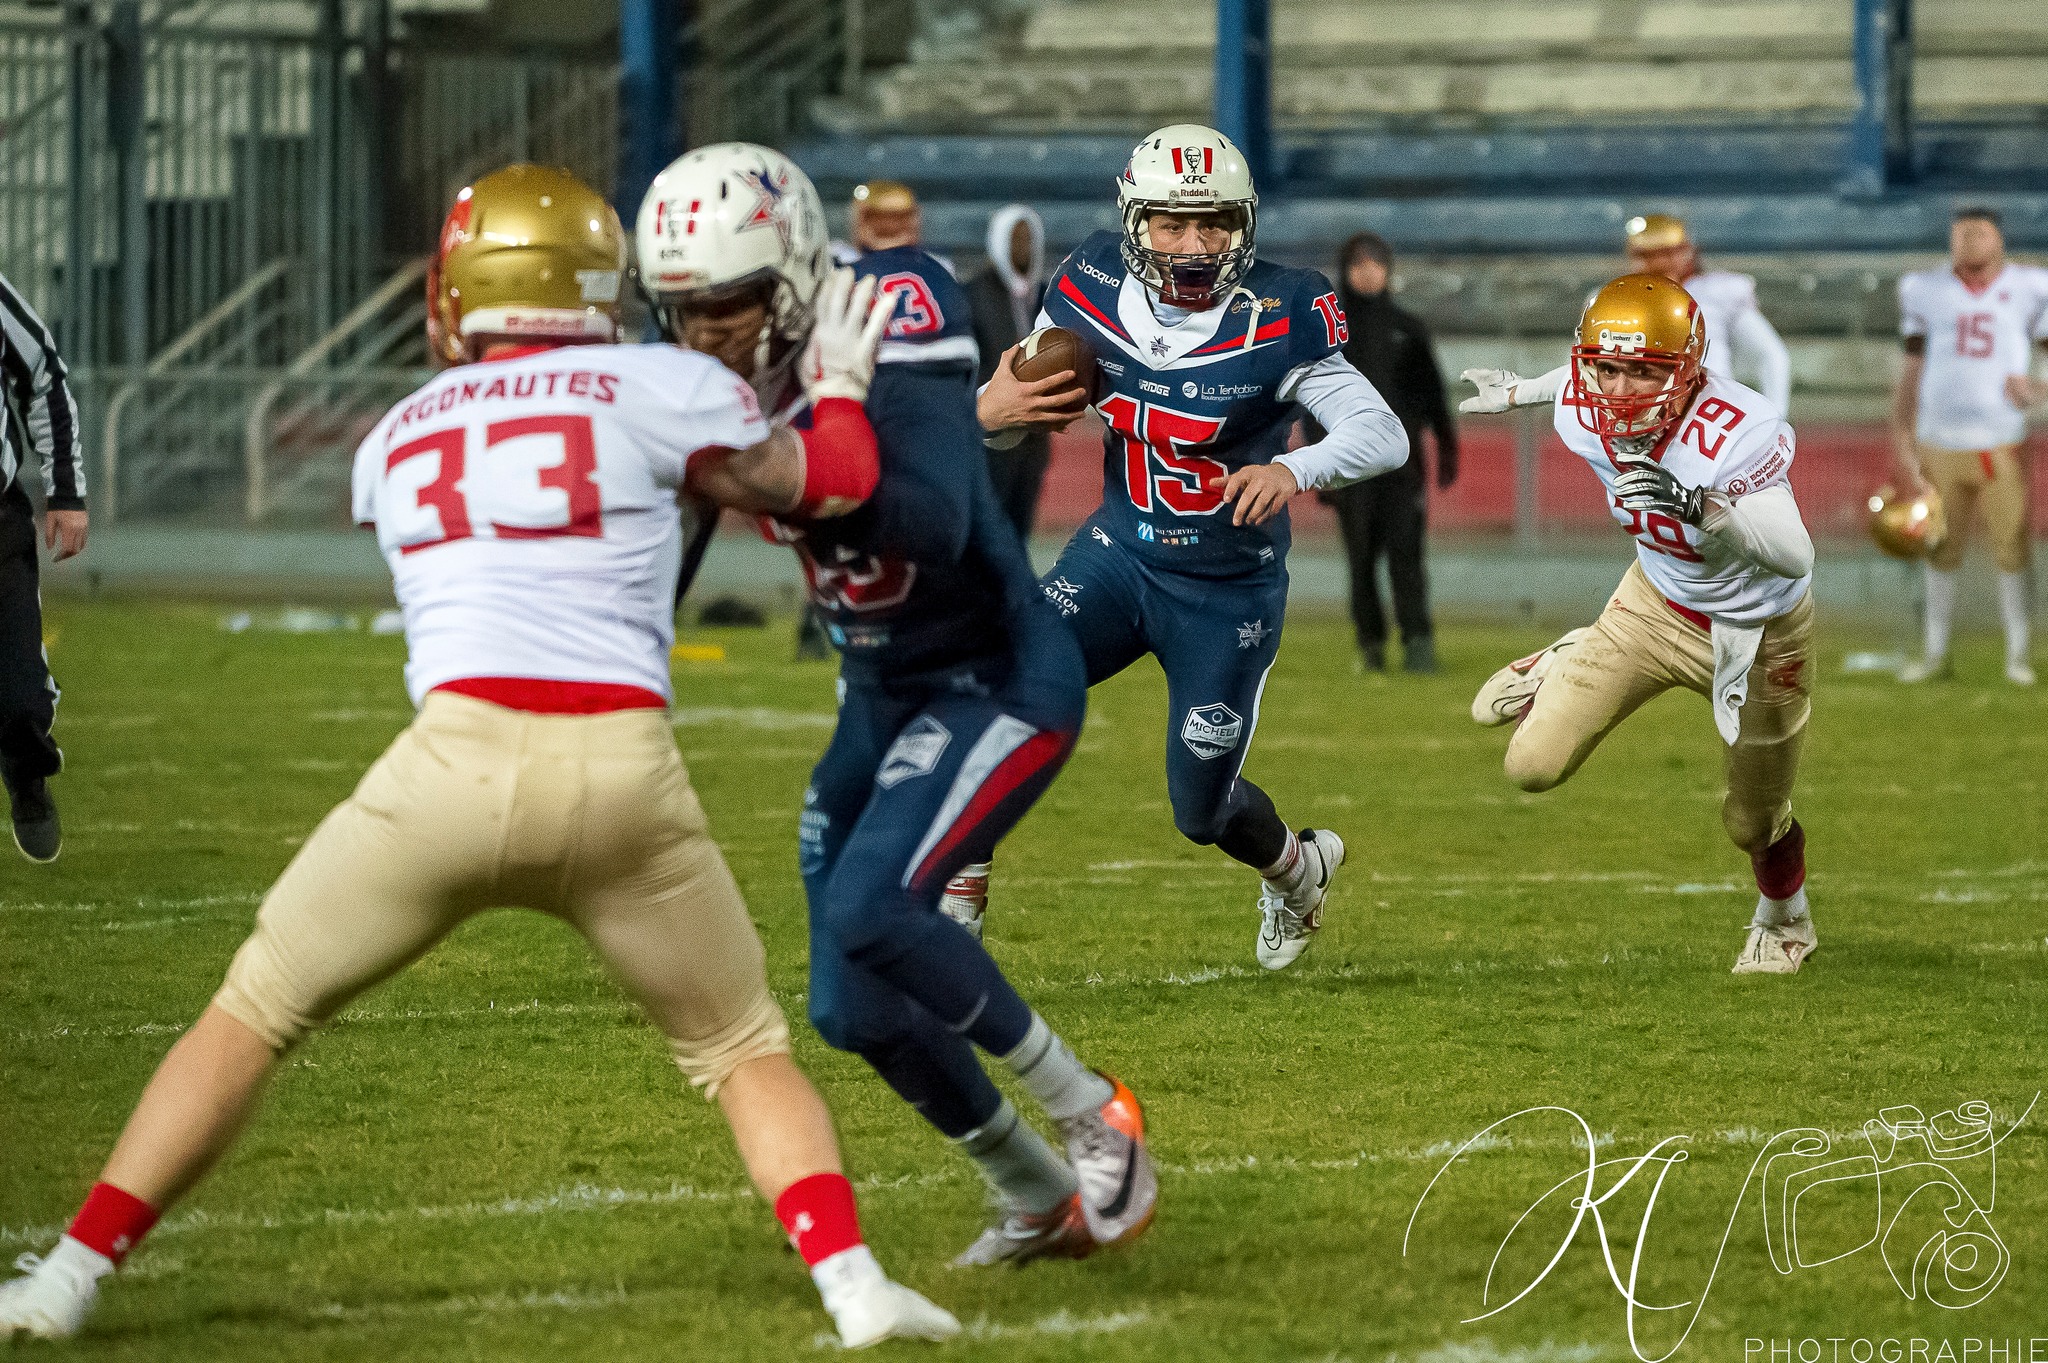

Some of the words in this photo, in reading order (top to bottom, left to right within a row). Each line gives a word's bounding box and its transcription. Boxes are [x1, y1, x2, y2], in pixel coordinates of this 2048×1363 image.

[1180, 188, 1209, 197] Riddell
[1181, 175, 1207, 185] KFC
[1311, 291, 1349, 347] 15
[1956, 313, 1996, 358] 15
[1201, 384, 1215, 395] La
[1218, 383, 1263, 395] Tentation
[1681, 396, 1747, 461] 29
[1096, 391, 1228, 516] 15
[1750, 450, 1781, 481] BOUCHES
[385, 414, 604, 556] 33
[1753, 477, 1766, 488] DU
[1614, 496, 1706, 563] 29
[1043, 587, 1080, 614] SALON
[1189, 719, 1236, 737] MICHELI
